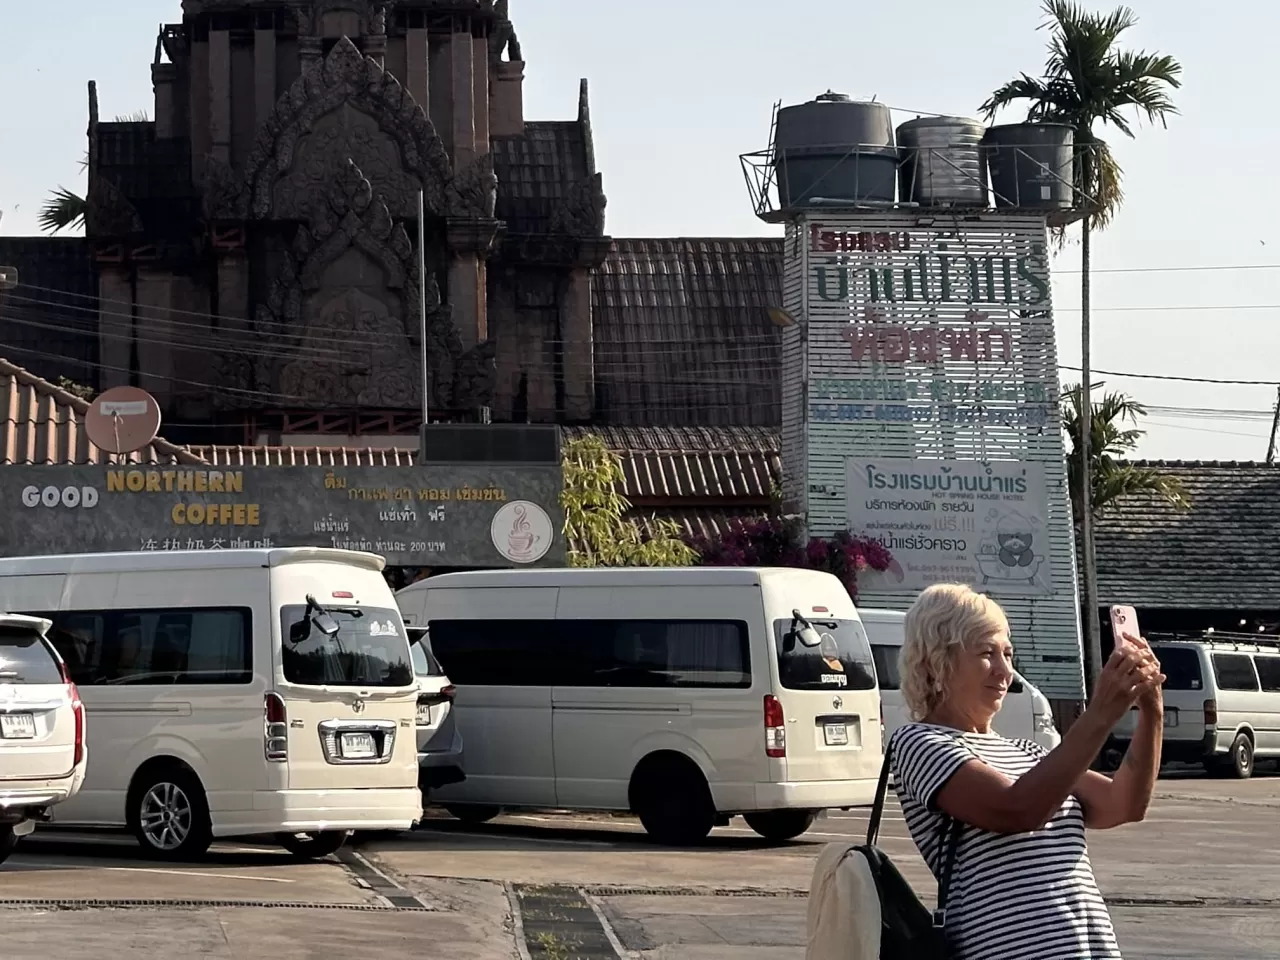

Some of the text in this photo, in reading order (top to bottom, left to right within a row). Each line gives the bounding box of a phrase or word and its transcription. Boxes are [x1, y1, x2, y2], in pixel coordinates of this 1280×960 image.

[842, 308, 1011, 362] ห้องพัก
[107, 470, 243, 493] NORTHERN
[865, 461, 1027, 493] โรงแรมบ้านน้ำแร่
[22, 485, 99, 508] GOOD
[418, 487, 450, 501] หอม
[172, 503, 260, 526] COFFEE
[379, 505, 446, 522] แช่เท้า ฟรี
[941, 500, 975, 513] รายวัน
[410, 542, 426, 552] 200
[428, 541, 446, 552] บาท
